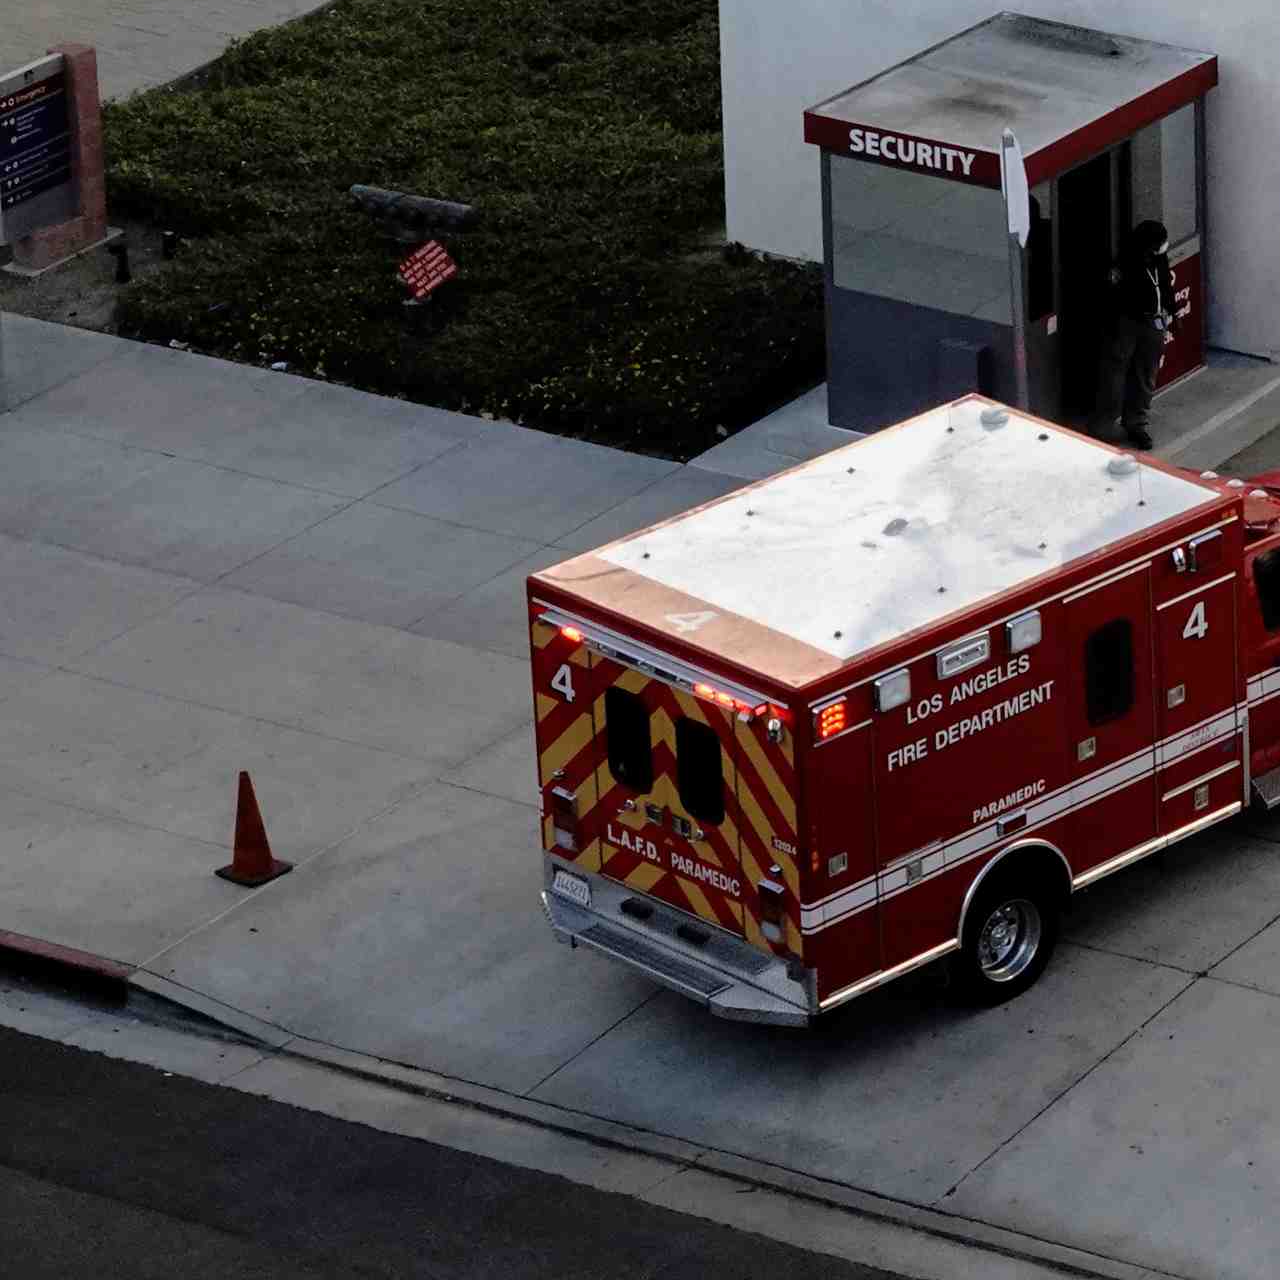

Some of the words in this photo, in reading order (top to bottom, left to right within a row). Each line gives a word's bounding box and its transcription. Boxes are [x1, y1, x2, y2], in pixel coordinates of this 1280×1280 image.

[849, 128, 976, 175] SECURITY
[1183, 601, 1209, 639] 4
[552, 664, 576, 703] 4
[907, 693, 943, 724] LOS
[950, 654, 1031, 705] ANGELES
[887, 738, 928, 772] FIRE
[935, 680, 1056, 751] DEPARTMENT
[972, 779, 1046, 824] PARAMEDIC
[607, 824, 661, 862] L.A.F.D.
[671, 852, 741, 897] PARAMEDIC
